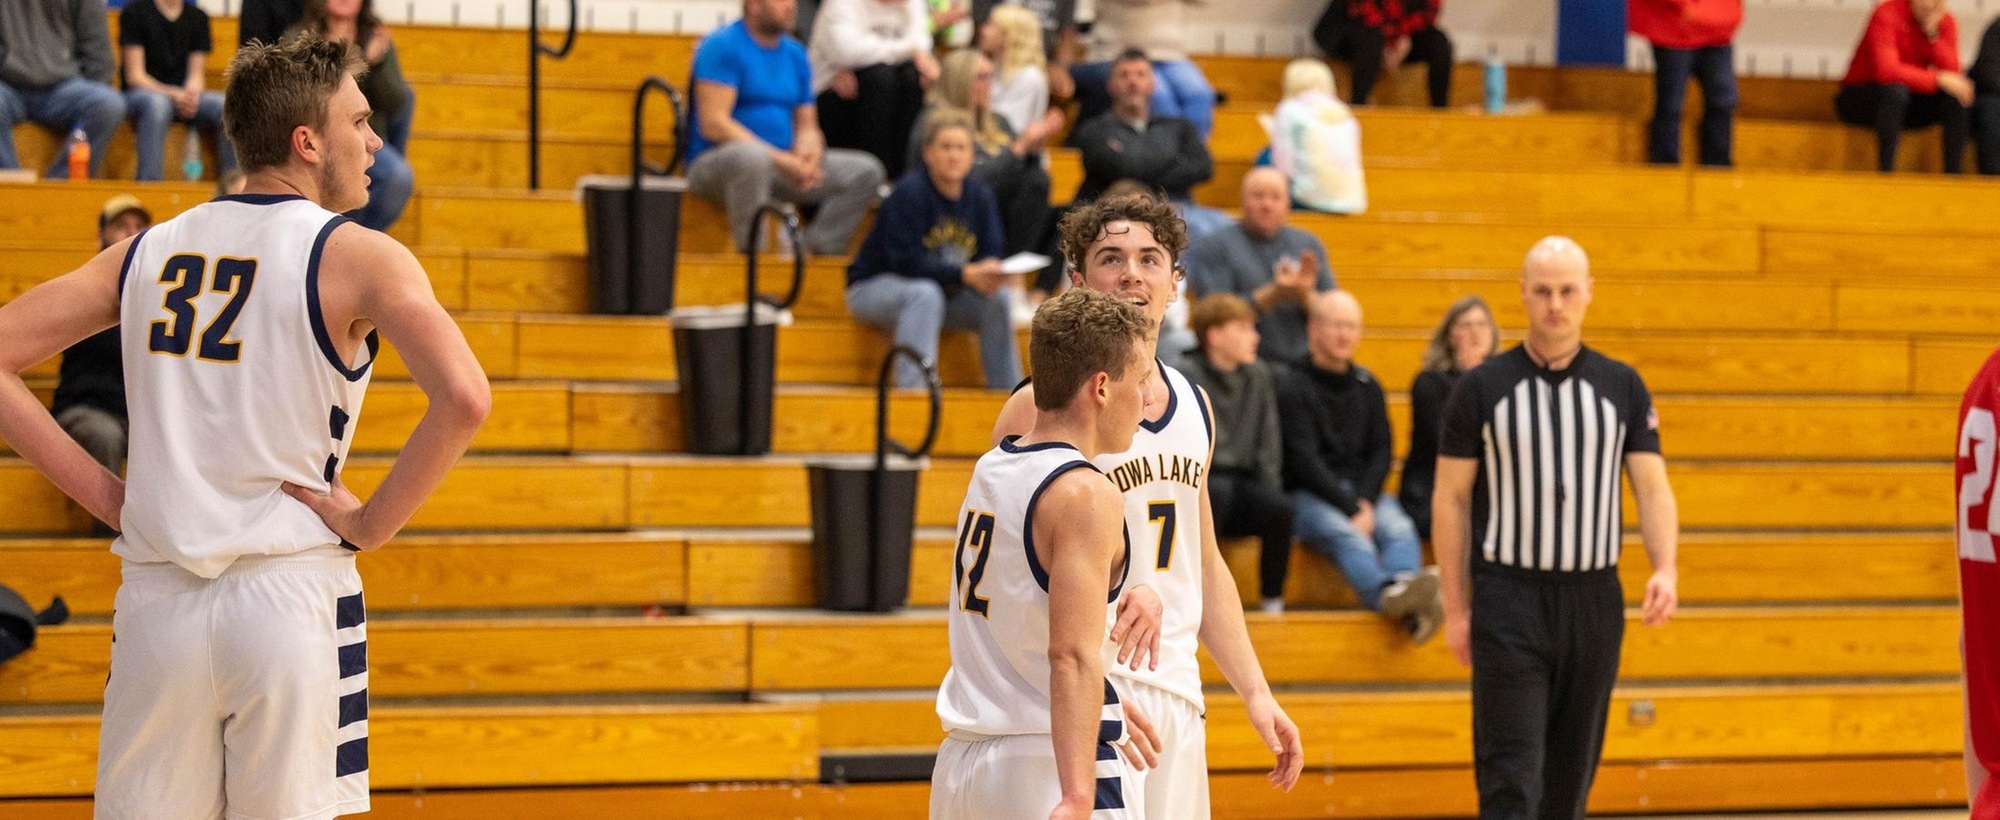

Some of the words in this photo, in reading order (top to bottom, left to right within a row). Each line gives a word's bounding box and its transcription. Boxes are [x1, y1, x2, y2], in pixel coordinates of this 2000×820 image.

[147, 252, 259, 363] 32
[1159, 453, 1204, 489] LAKE
[955, 508, 995, 620] 12
[1147, 500, 1176, 572] 7
